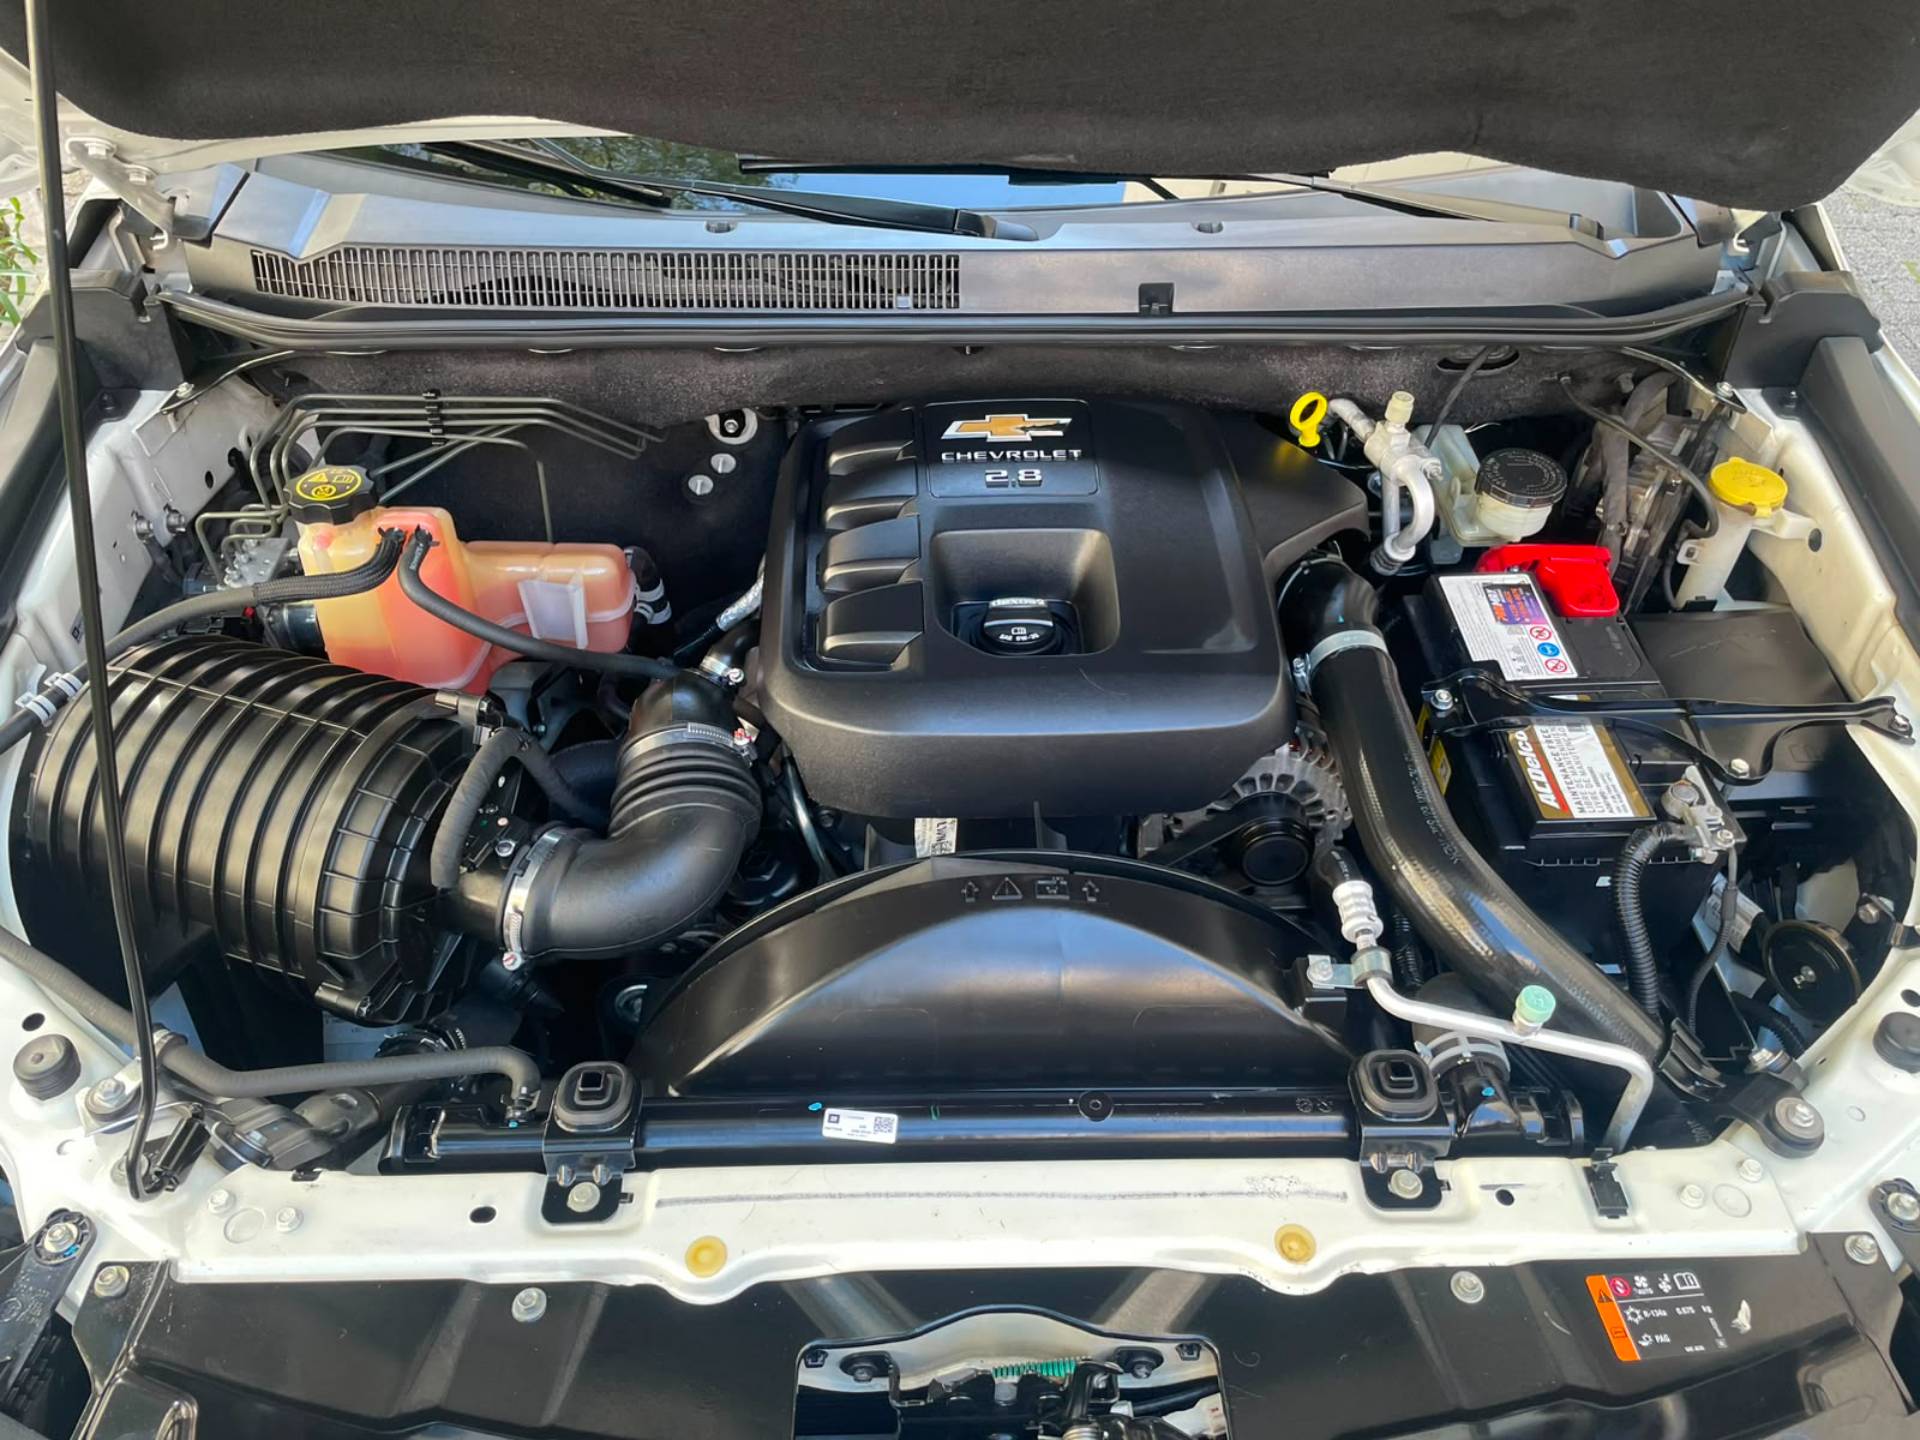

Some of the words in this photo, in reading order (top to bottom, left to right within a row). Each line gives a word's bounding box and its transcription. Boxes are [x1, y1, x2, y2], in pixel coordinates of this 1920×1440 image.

[941, 449, 1082, 463] CHEVROLET
[985, 468, 1043, 488] 2.8
[1540, 728, 1557, 749] FREE
[1515, 730, 1560, 811] ACDelco
[1551, 751, 1586, 813] MAINTENANCE
[1573, 778, 1585, 789] DE
[1582, 778, 1593, 788] DE
[1588, 790, 1606, 813] LIVRE
[1654, 1333, 1672, 1344] PAG
